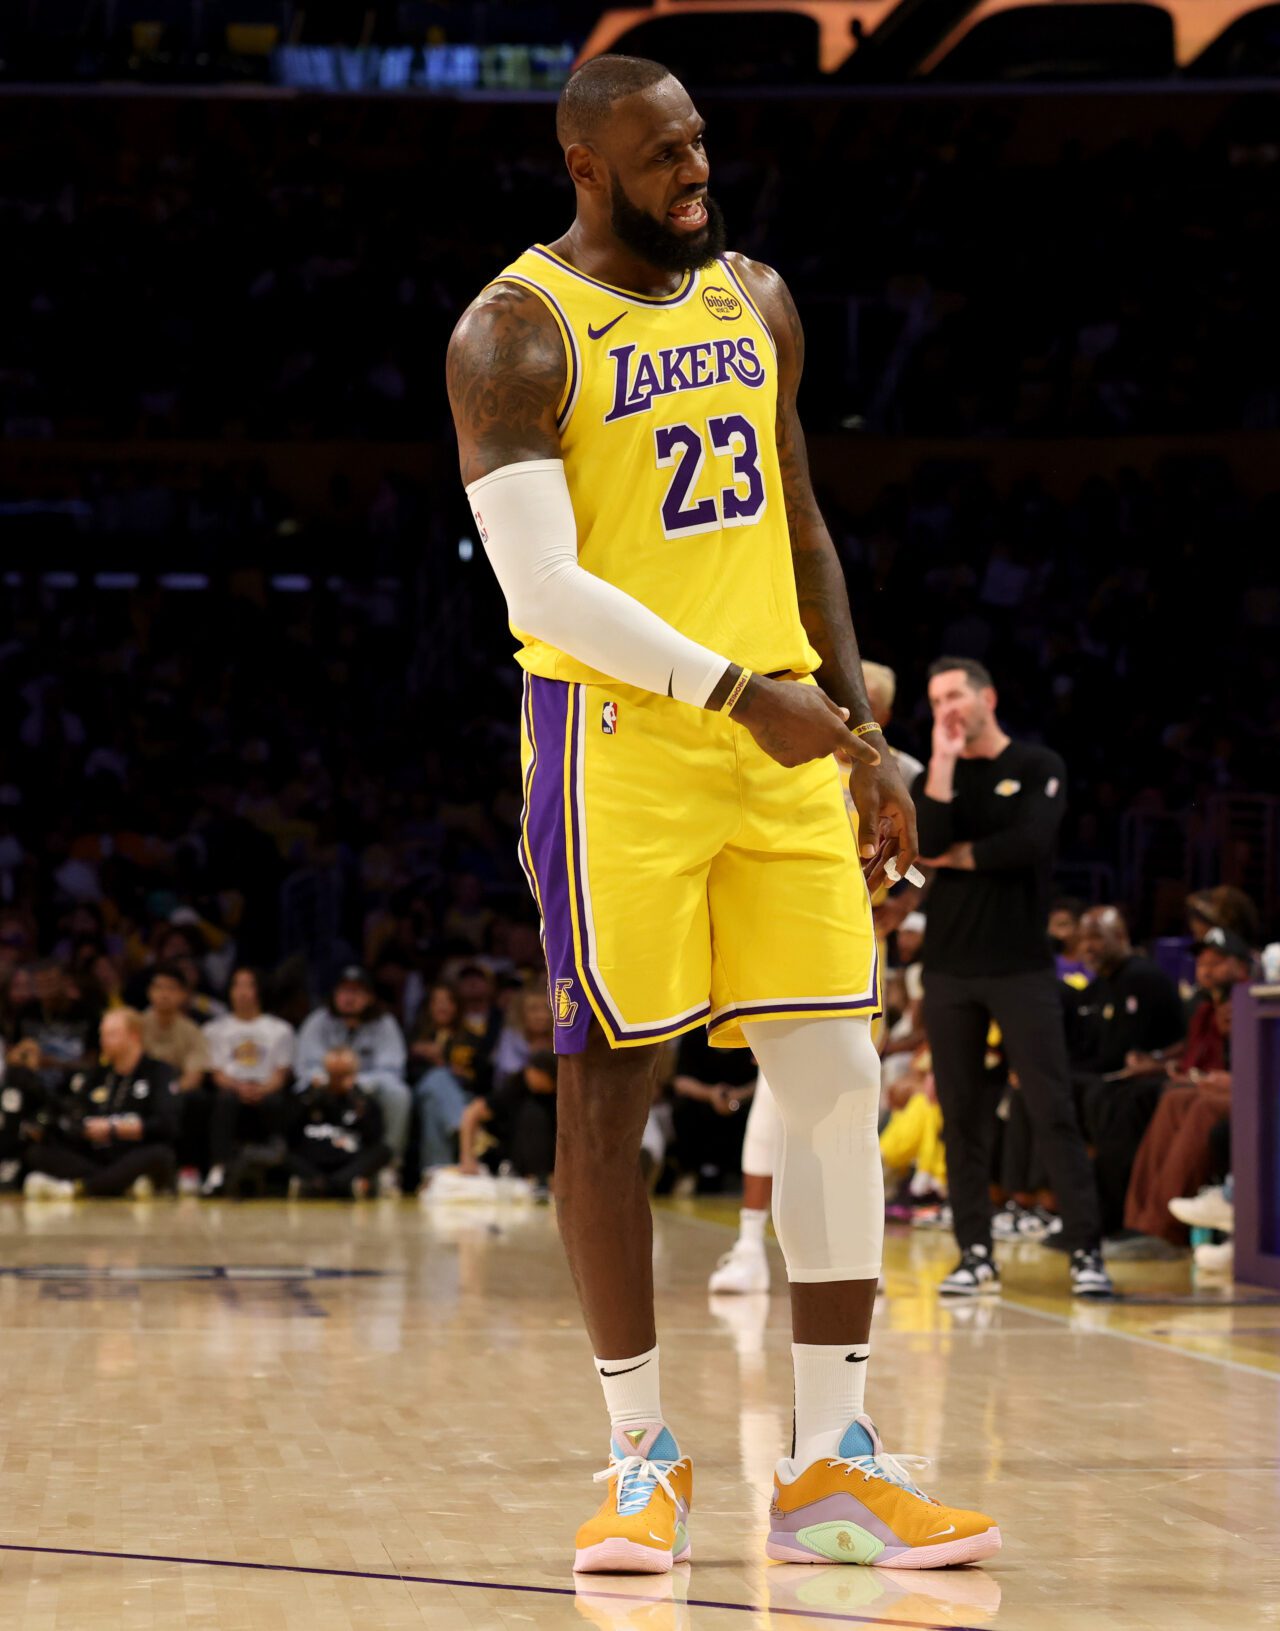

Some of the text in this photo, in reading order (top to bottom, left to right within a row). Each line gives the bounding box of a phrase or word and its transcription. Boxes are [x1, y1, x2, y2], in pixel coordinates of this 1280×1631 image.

[705, 295, 738, 310] bibigo
[604, 337, 766, 423] LAKERS
[655, 413, 767, 540] 23
[726, 677, 746, 707] PROMISE
